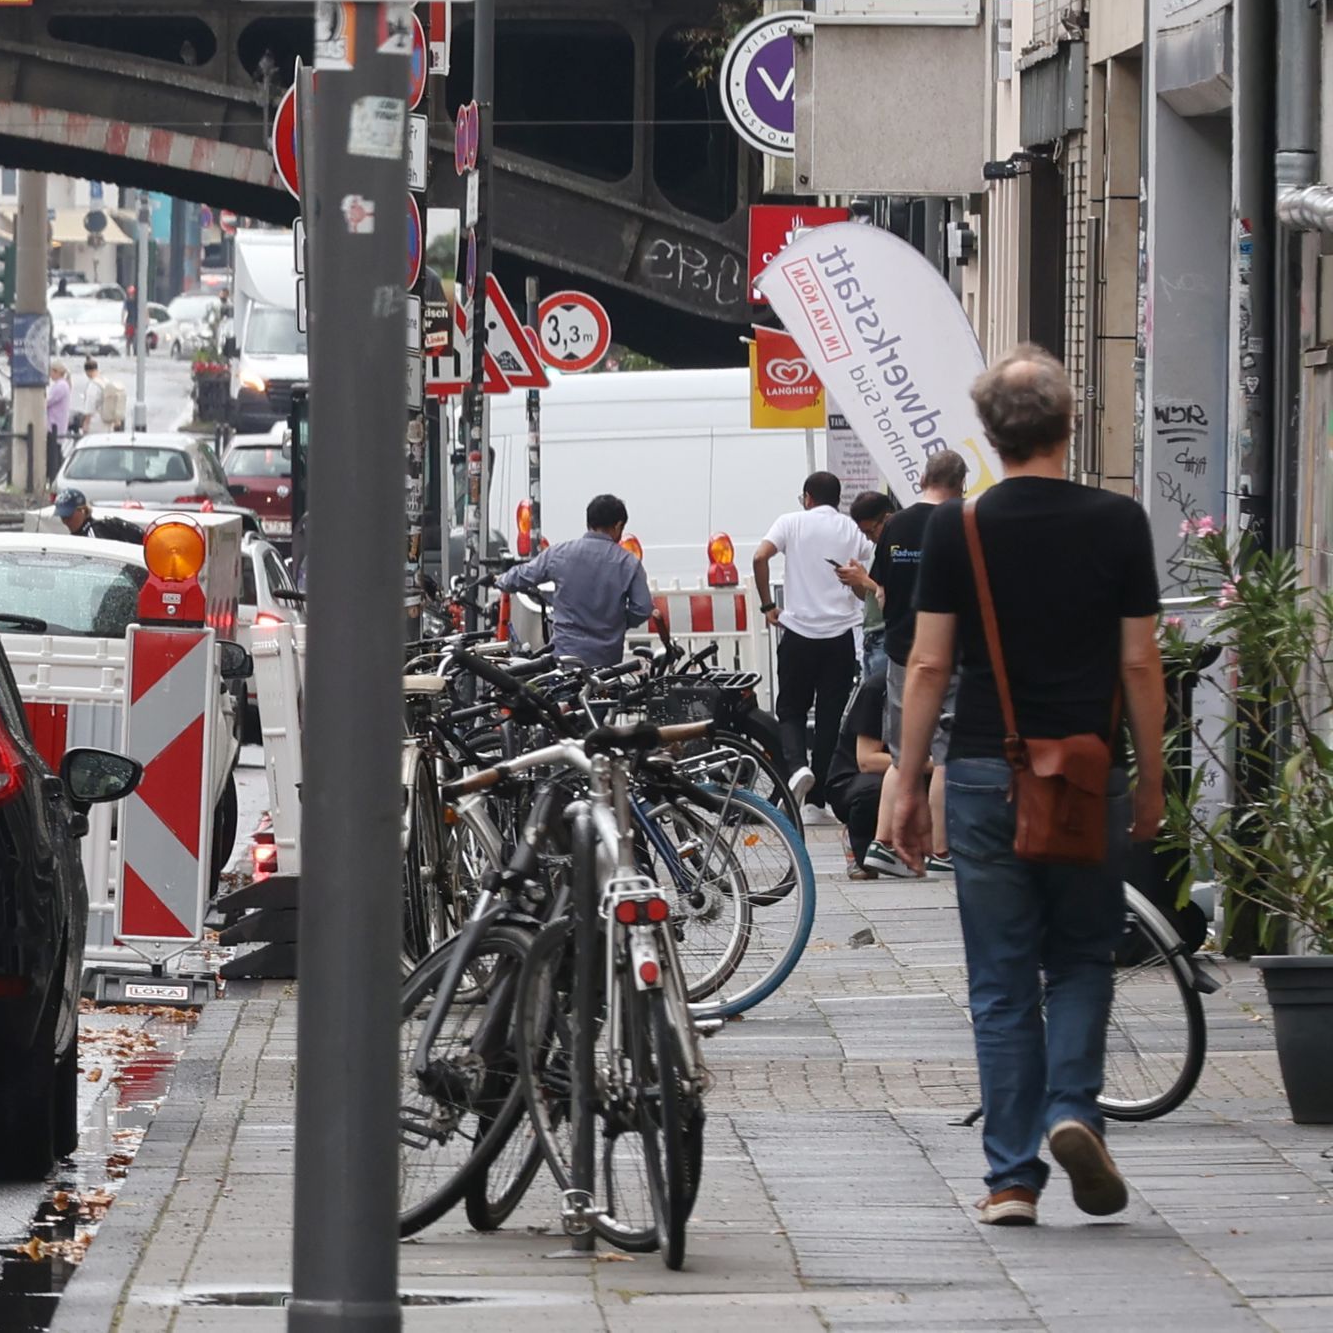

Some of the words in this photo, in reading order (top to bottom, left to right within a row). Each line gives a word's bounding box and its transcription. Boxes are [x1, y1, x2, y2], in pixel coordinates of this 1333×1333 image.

[744, 23, 801, 54] VISIO
[547, 314, 580, 352] 3,3
[766, 385, 815, 396] LANGNESE
